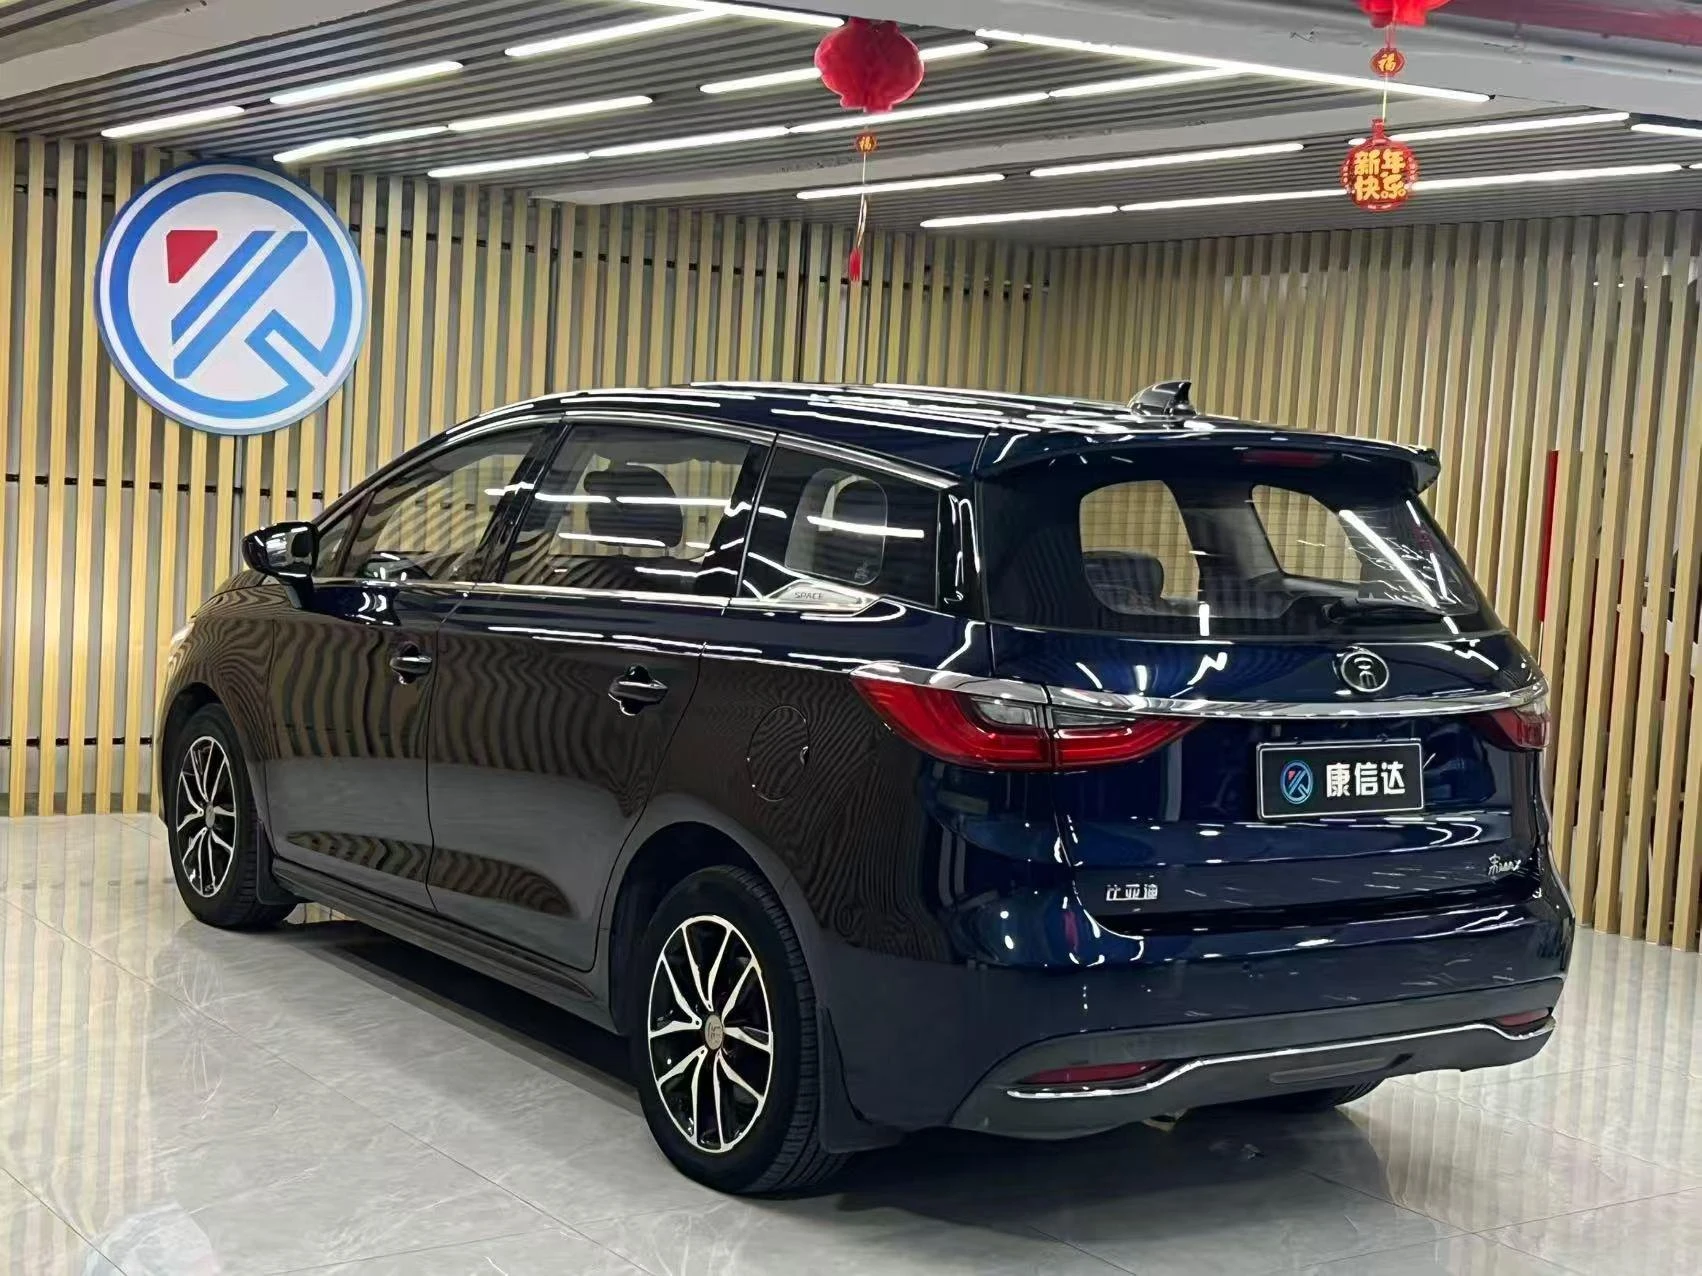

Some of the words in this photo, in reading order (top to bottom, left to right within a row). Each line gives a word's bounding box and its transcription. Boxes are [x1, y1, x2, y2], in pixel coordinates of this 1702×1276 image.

[1378, 53, 1397, 72] 福
[1354, 149, 1405, 176] 新年
[1354, 172, 1406, 200] 快乐
[1326, 761, 1405, 797] 康信达
[1106, 884, 1158, 901] 比亚迪
